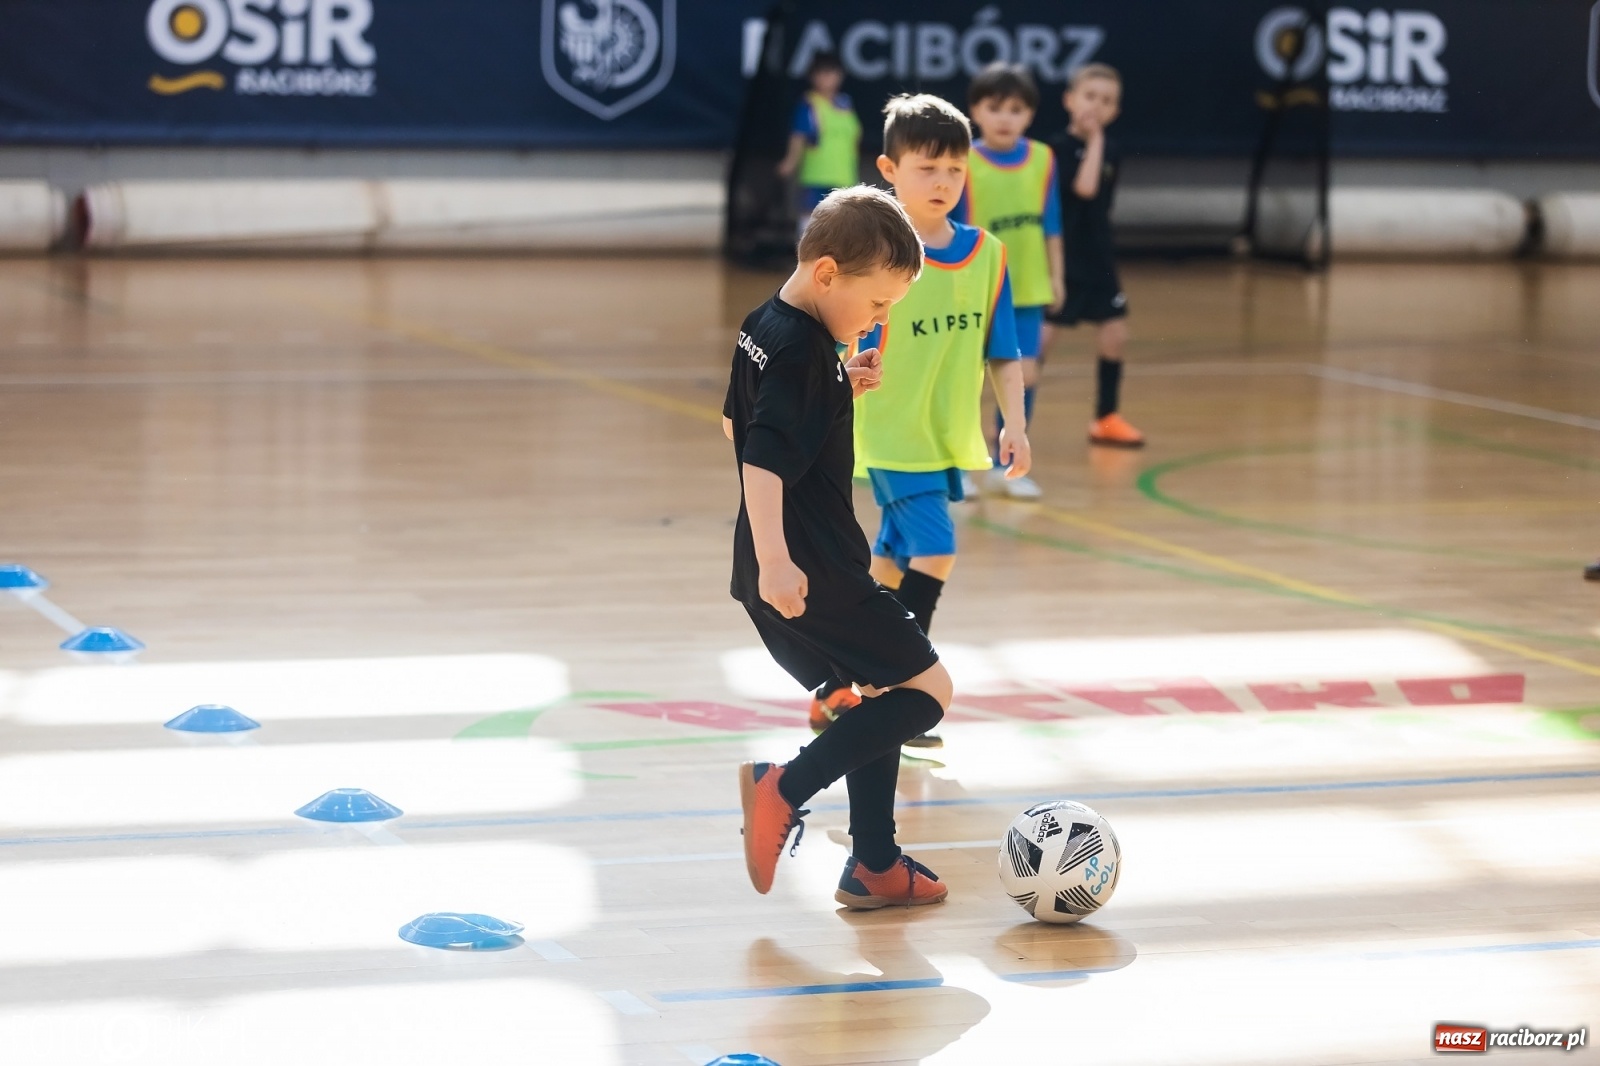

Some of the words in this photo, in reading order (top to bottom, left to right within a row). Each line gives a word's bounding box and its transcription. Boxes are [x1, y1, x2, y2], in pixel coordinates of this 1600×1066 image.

[1036, 812, 1051, 844] adidas
[1084, 856, 1100, 881] AP
[1091, 861, 1115, 896] GOL
